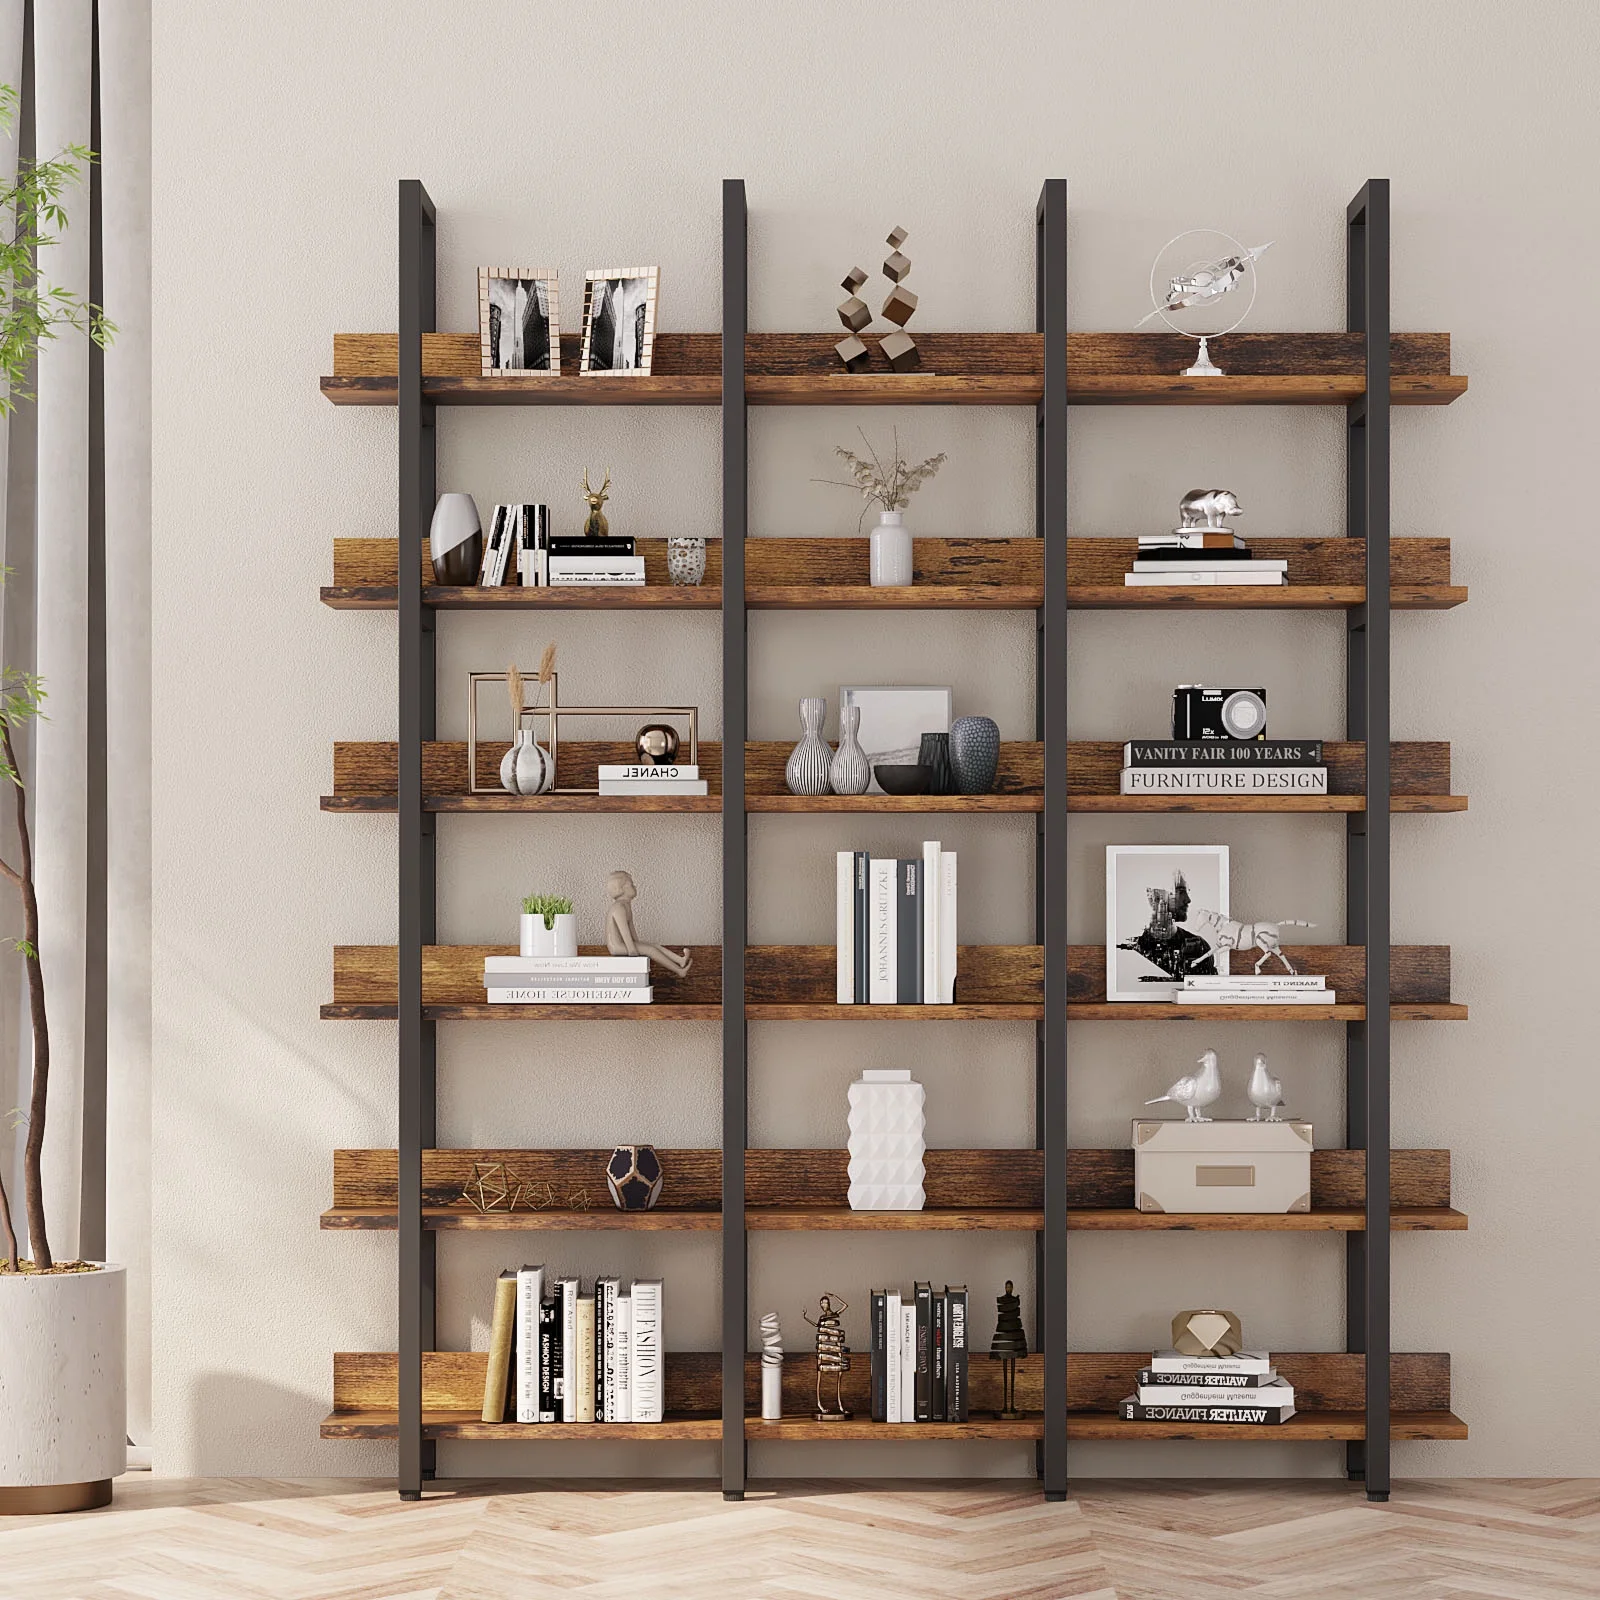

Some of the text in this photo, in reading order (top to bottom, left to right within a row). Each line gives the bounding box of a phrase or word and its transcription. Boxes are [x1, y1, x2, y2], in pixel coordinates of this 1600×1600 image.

[1134, 747, 1188, 760] VANITY
[1192, 747, 1225, 760] FAIR
[1230, 747, 1250, 760] 100
[1254, 747, 1301, 760] YEARS
[1131, 773, 1324, 788] FURNITURE DESIGN
[636, 1288, 656, 1317] THE
[542, 1334, 550, 1366] FASHION
[636, 1319, 656, 1378] FASHION
[542, 1367, 550, 1392] DESIGN
